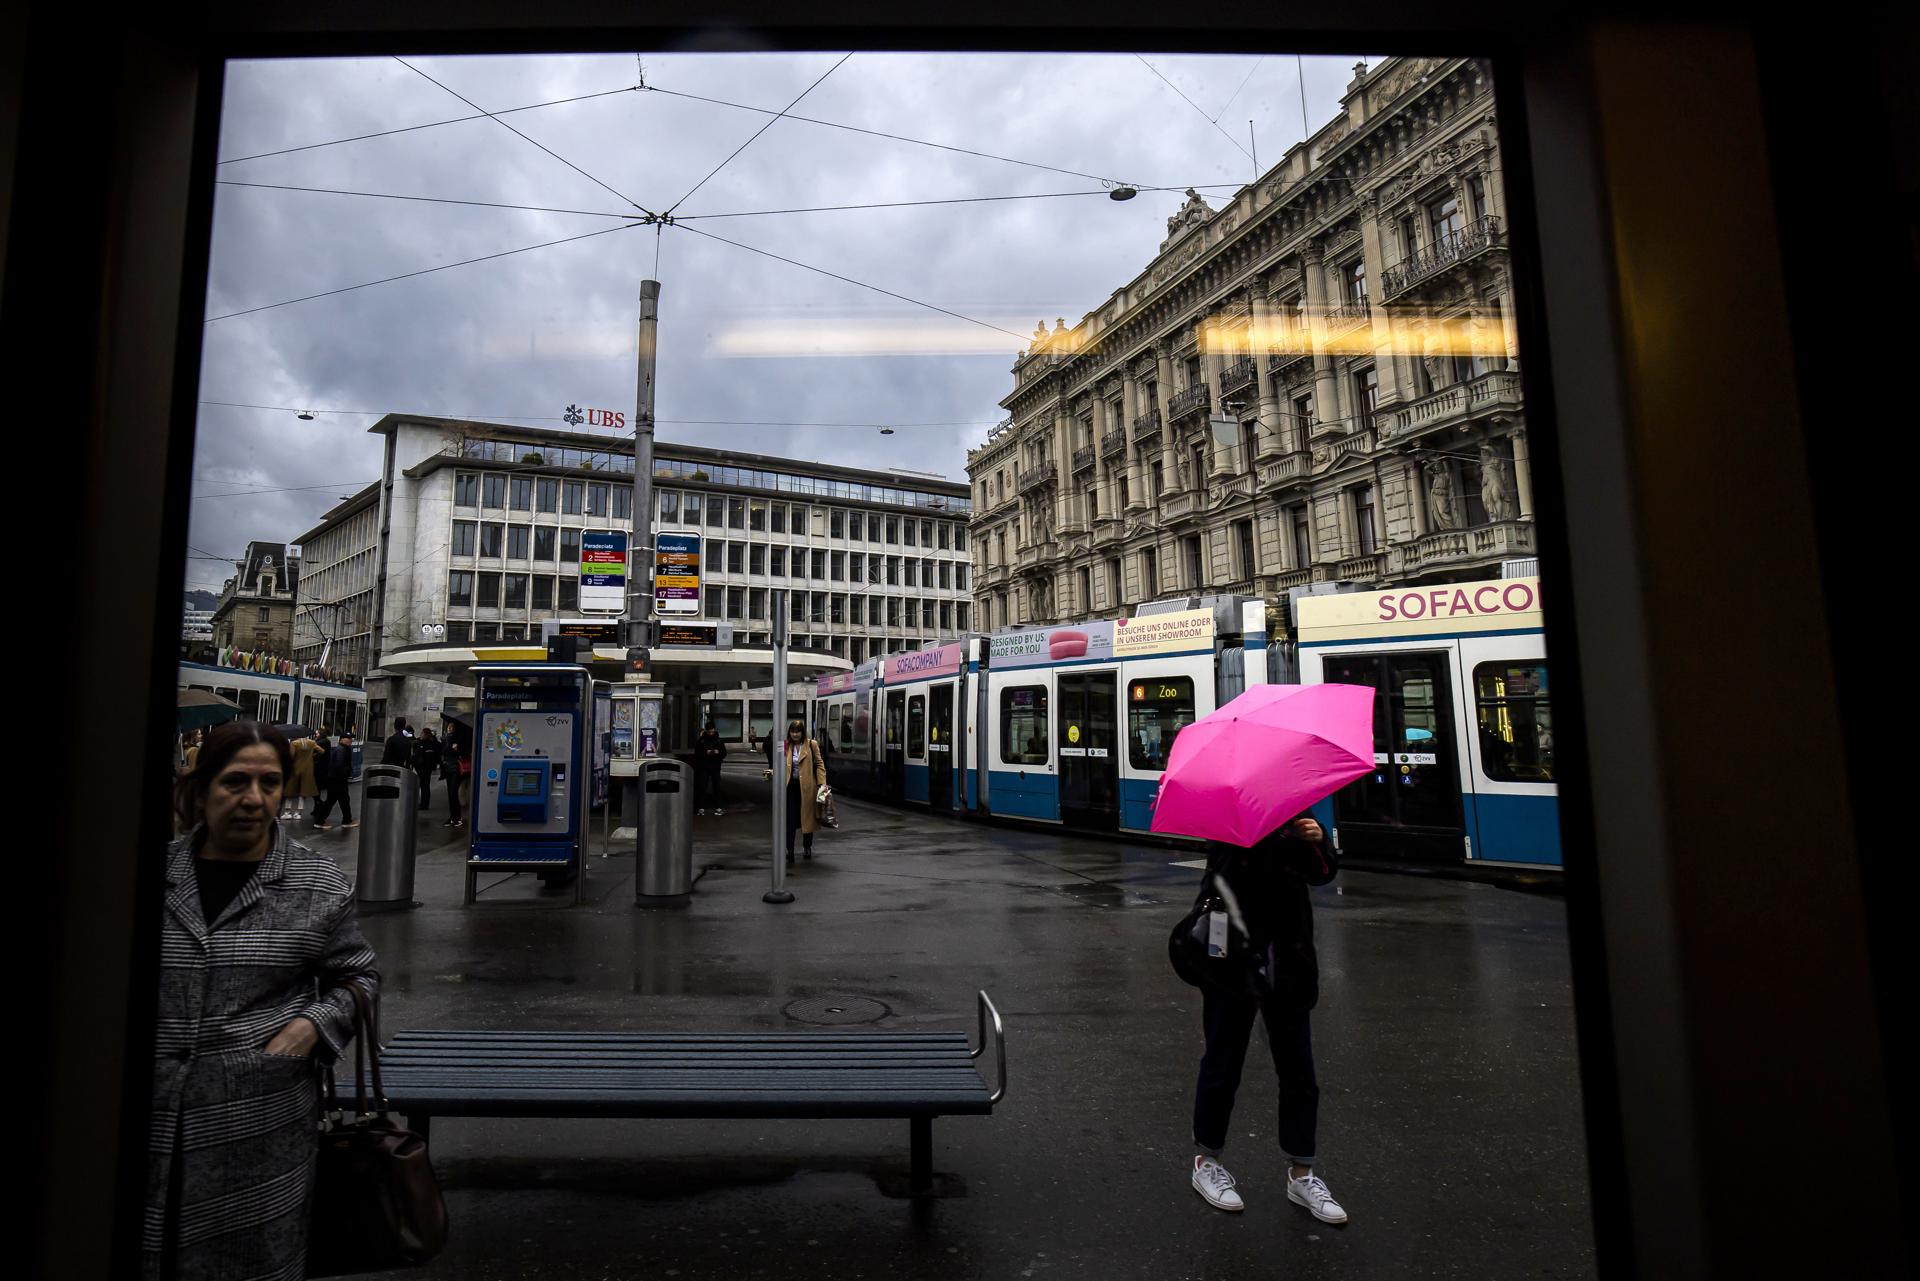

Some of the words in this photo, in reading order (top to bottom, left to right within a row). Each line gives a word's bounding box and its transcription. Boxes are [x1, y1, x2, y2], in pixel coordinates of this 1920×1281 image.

[588, 409, 625, 428] UBS
[1117, 625, 1145, 636] BESUCHE
[1146, 623, 1160, 632] UNS
[1162, 620, 1189, 630] ONLINE
[1191, 618, 1211, 627] ODER
[991, 635, 1023, 647] DESIGNED
[1024, 634, 1034, 643] BY
[1125, 633, 1157, 644] UNSEREM
[1158, 628, 1202, 640] SHOWROOM
[991, 647, 1009, 657] MADE
[1010, 645, 1024, 655] FOR
[1025, 644, 1041, 653] YOU
[896, 650, 944, 673] SOFACOMPANY
[486, 692, 529, 700] Paradeplatz
[1136, 688, 1142, 697] 6
[1160, 685, 1177, 697] Zoo
